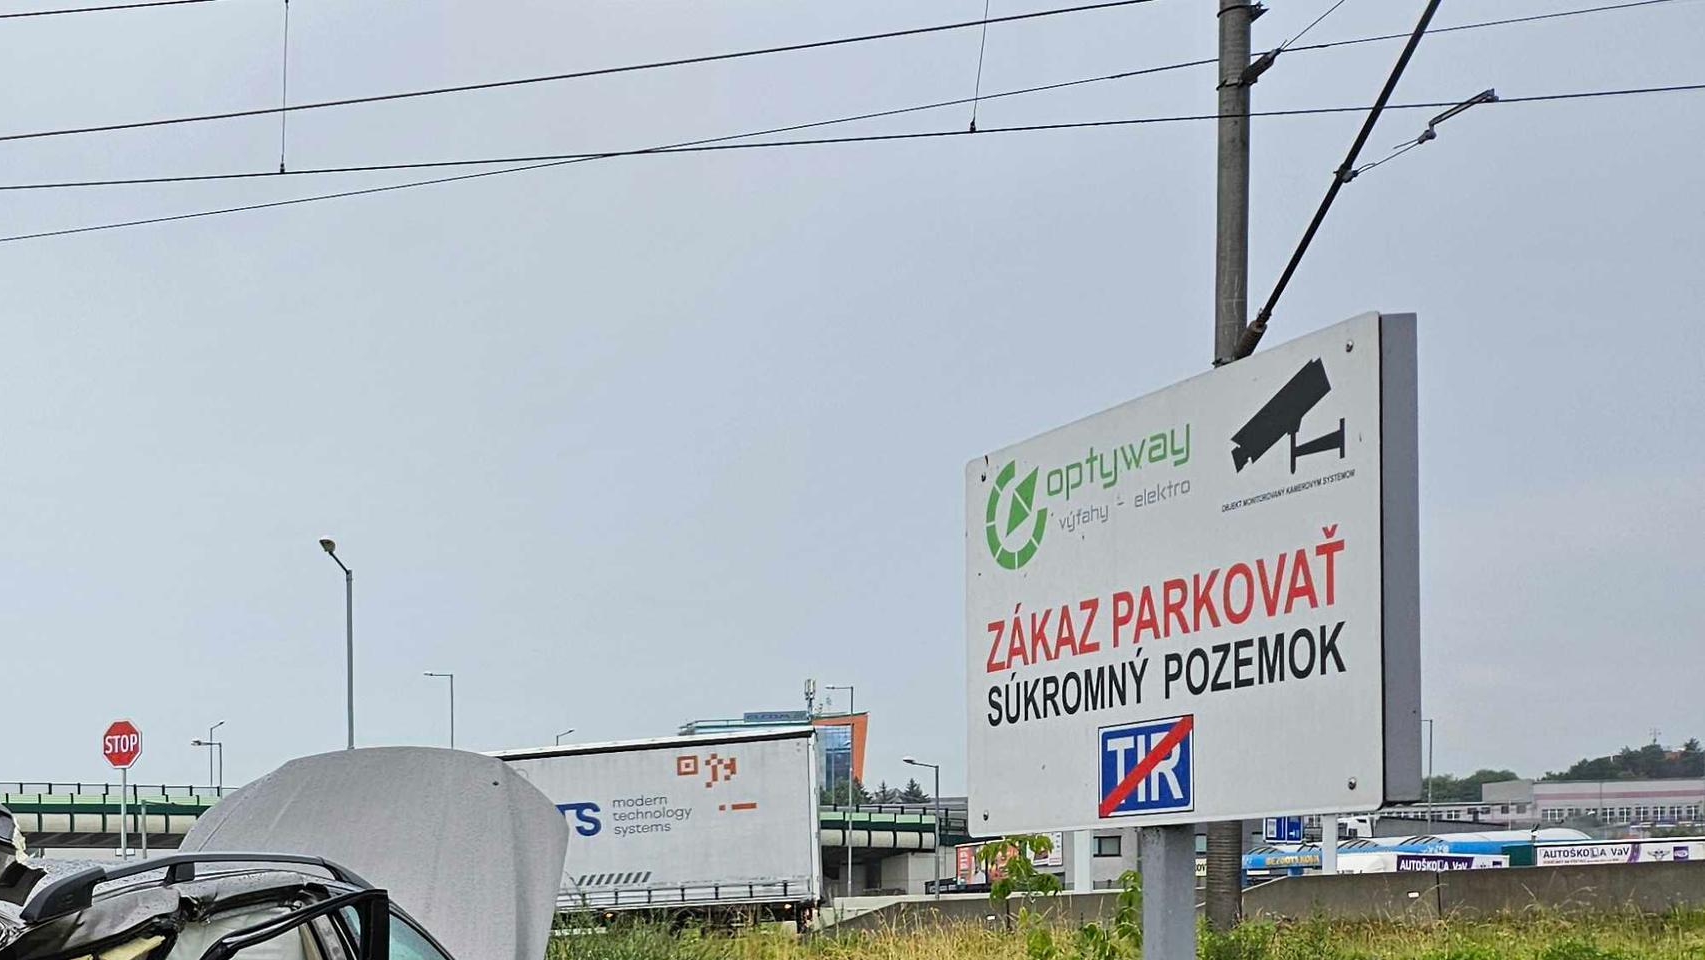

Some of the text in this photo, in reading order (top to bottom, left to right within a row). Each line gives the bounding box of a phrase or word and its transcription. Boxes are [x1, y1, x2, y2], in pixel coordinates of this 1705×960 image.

[1047, 423, 1190, 501] optyway
[1134, 480, 1191, 508] elektro
[986, 523, 1346, 673] ZÁKAZ PARKOVAŤ
[987, 621, 1347, 727] SÚKROMNÝ POZEMOK
[105, 734, 138, 754] STOP
[1107, 731, 1184, 804] TIR
[612, 795, 668, 808] modern
[612, 807, 693, 821] technology
[614, 821, 672, 838] systems
[1543, 846, 1630, 860] AUTOŠKOLA VaV
[1399, 858, 1450, 872] AUTOŠKOLA
